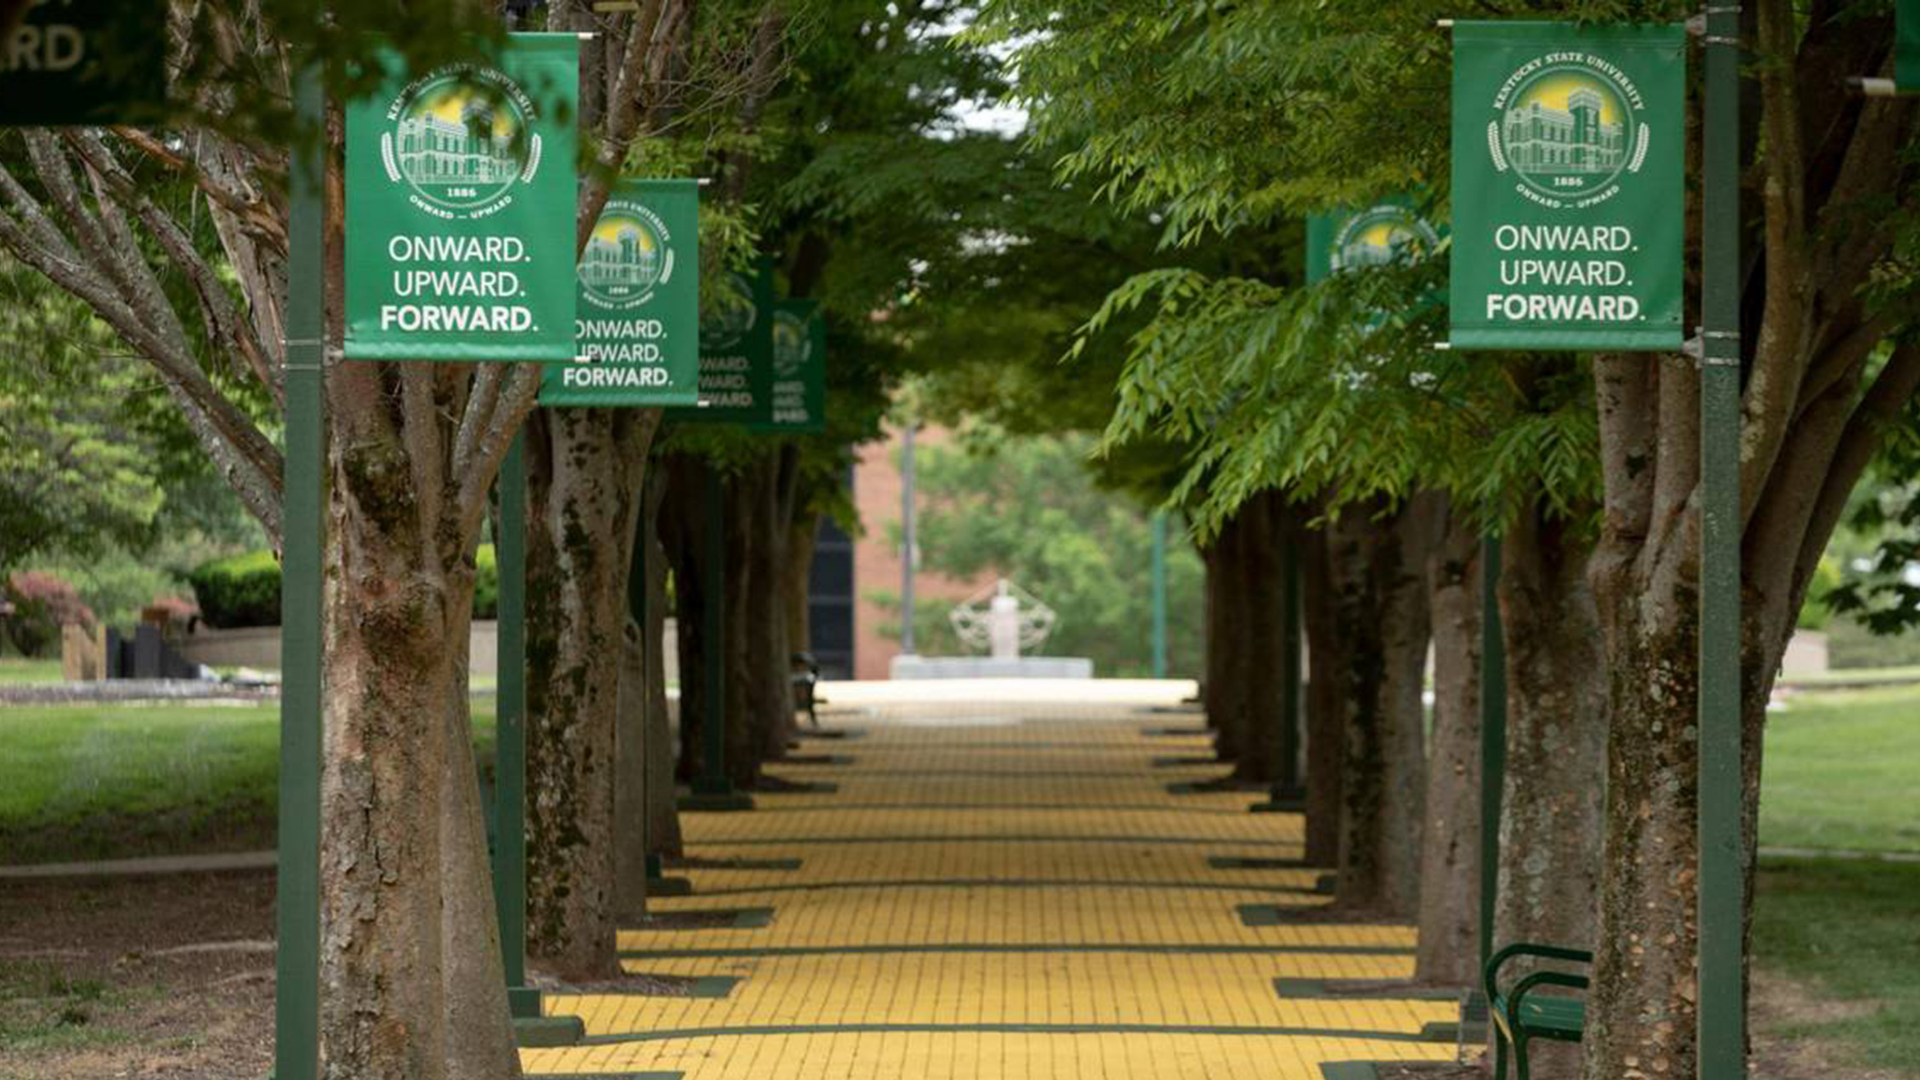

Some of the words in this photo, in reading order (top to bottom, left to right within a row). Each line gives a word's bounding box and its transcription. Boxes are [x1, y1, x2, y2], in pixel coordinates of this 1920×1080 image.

[1493, 57, 1543, 110] KENTUCKY
[1545, 52, 1584, 64] STATE
[1586, 55, 1645, 110] UNIVERSITY
[409, 194, 454, 219] ONWARD
[469, 194, 513, 219] UPWARD
[1515, 183, 1562, 209] ONWARD
[1576, 184, 1620, 209] UPWARD
[388, 235, 531, 262] ONWARD.
[1495, 224, 1639, 252] ONWARD.
[393, 270, 526, 297] UPWARD.
[1500, 259, 1633, 287] UPWARD.
[381, 305, 539, 332] FORWARD.
[1487, 293, 1646, 322] FORWARD.
[563, 367, 674, 387] FORWARD.
